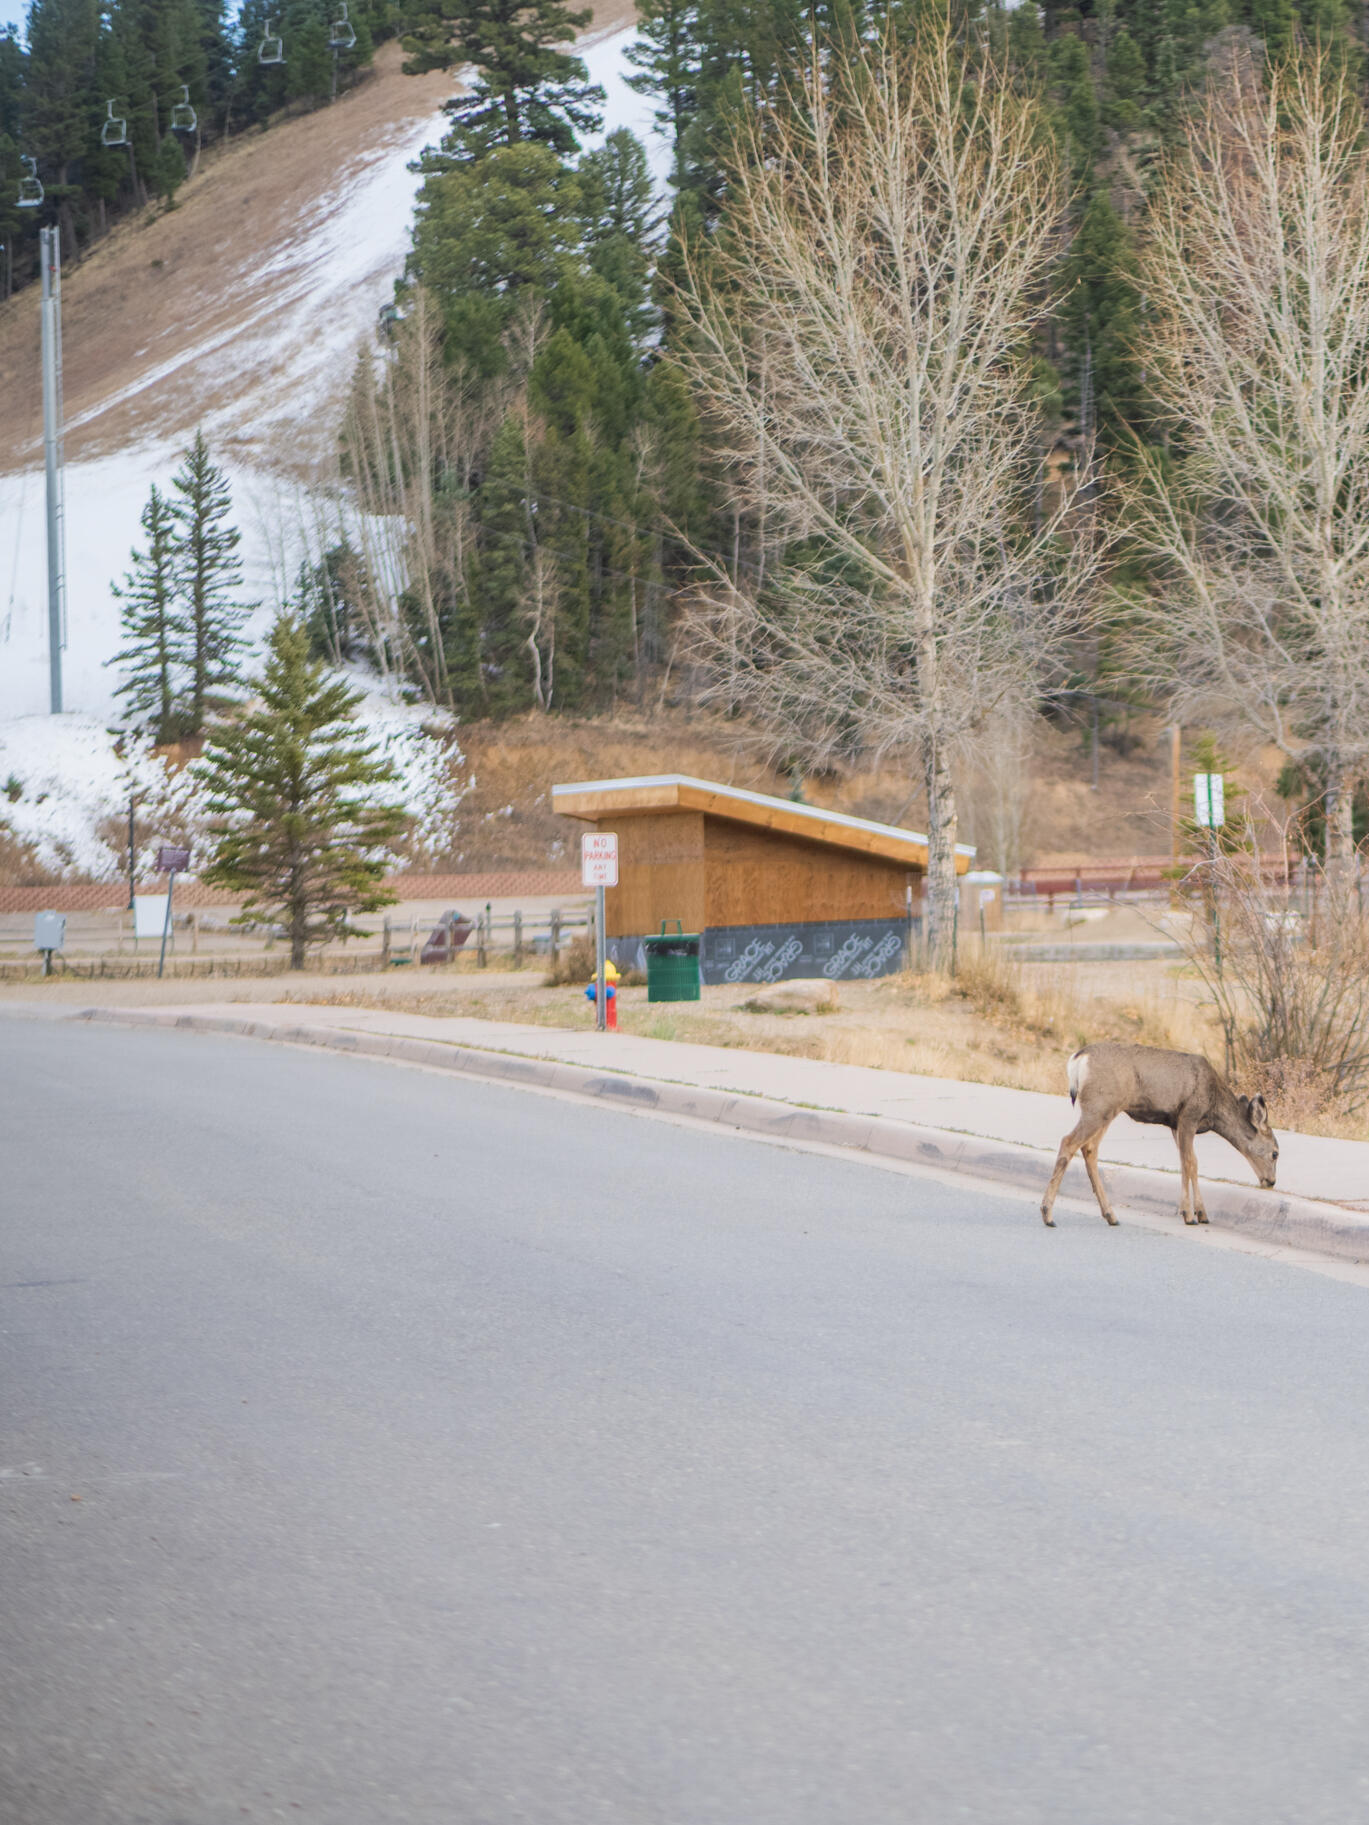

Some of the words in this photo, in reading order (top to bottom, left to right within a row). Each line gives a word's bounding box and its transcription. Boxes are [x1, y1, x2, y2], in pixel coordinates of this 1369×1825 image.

[583, 851, 617, 861] PARKING
[593, 838, 607, 848] NO
[724, 937, 763, 983] GRACE
[764, 939, 804, 984] GRACE
[823, 932, 863, 977] GRACE
[862, 934, 902, 979] GRACE
